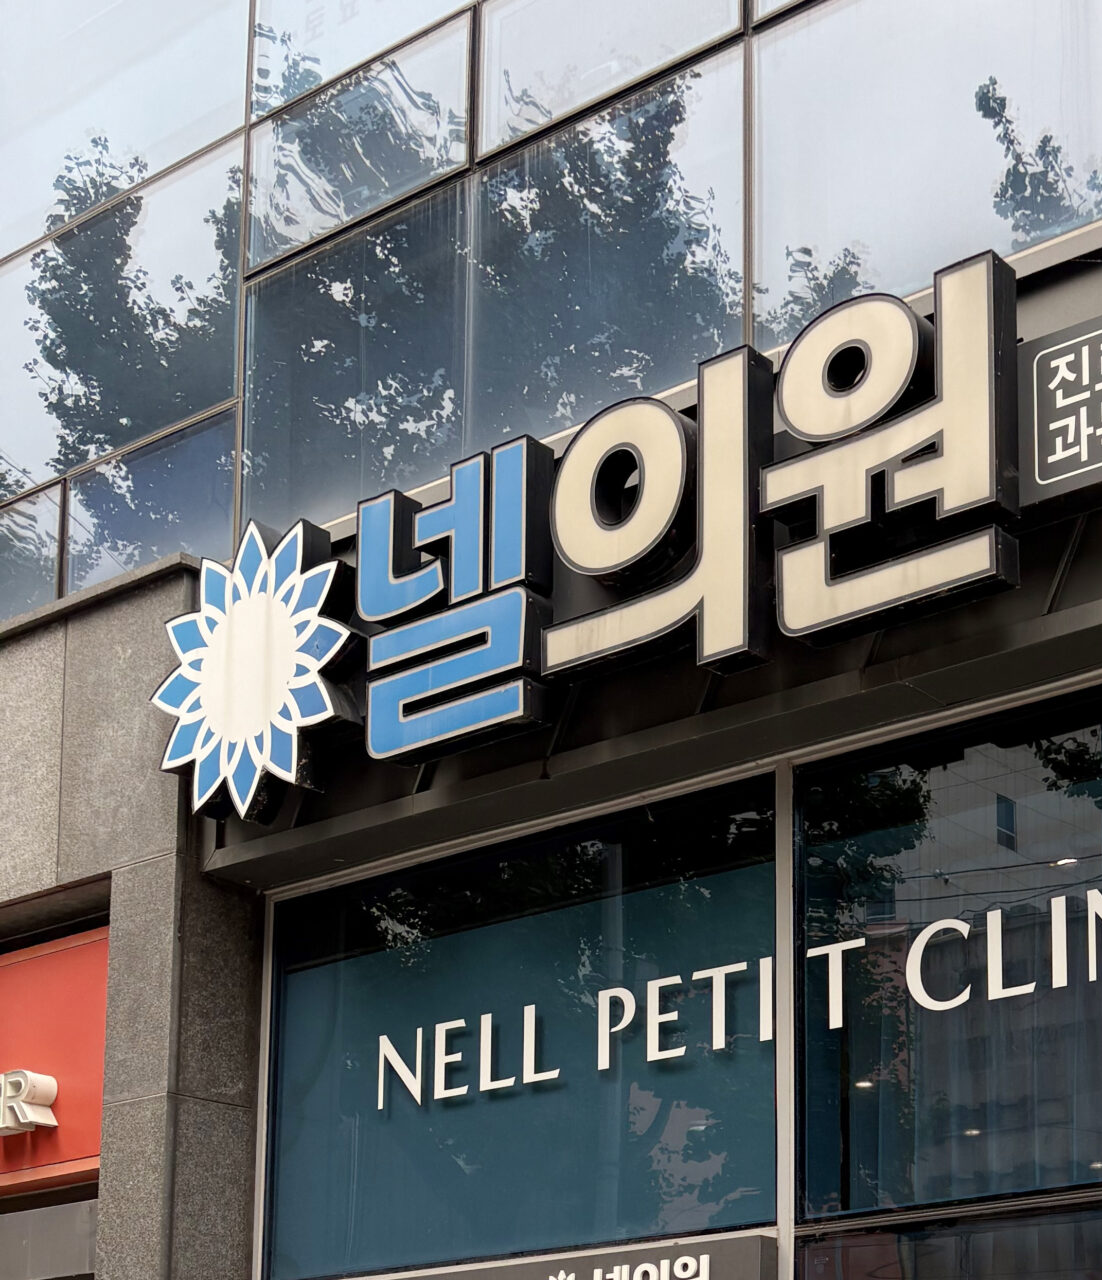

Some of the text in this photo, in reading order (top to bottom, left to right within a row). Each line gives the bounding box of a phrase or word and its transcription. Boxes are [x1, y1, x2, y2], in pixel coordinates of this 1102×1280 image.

[357, 251, 1000, 761] 넬의원
[377, 1005, 560, 1110] NELL
[598, 937, 866, 1070] PETIT
